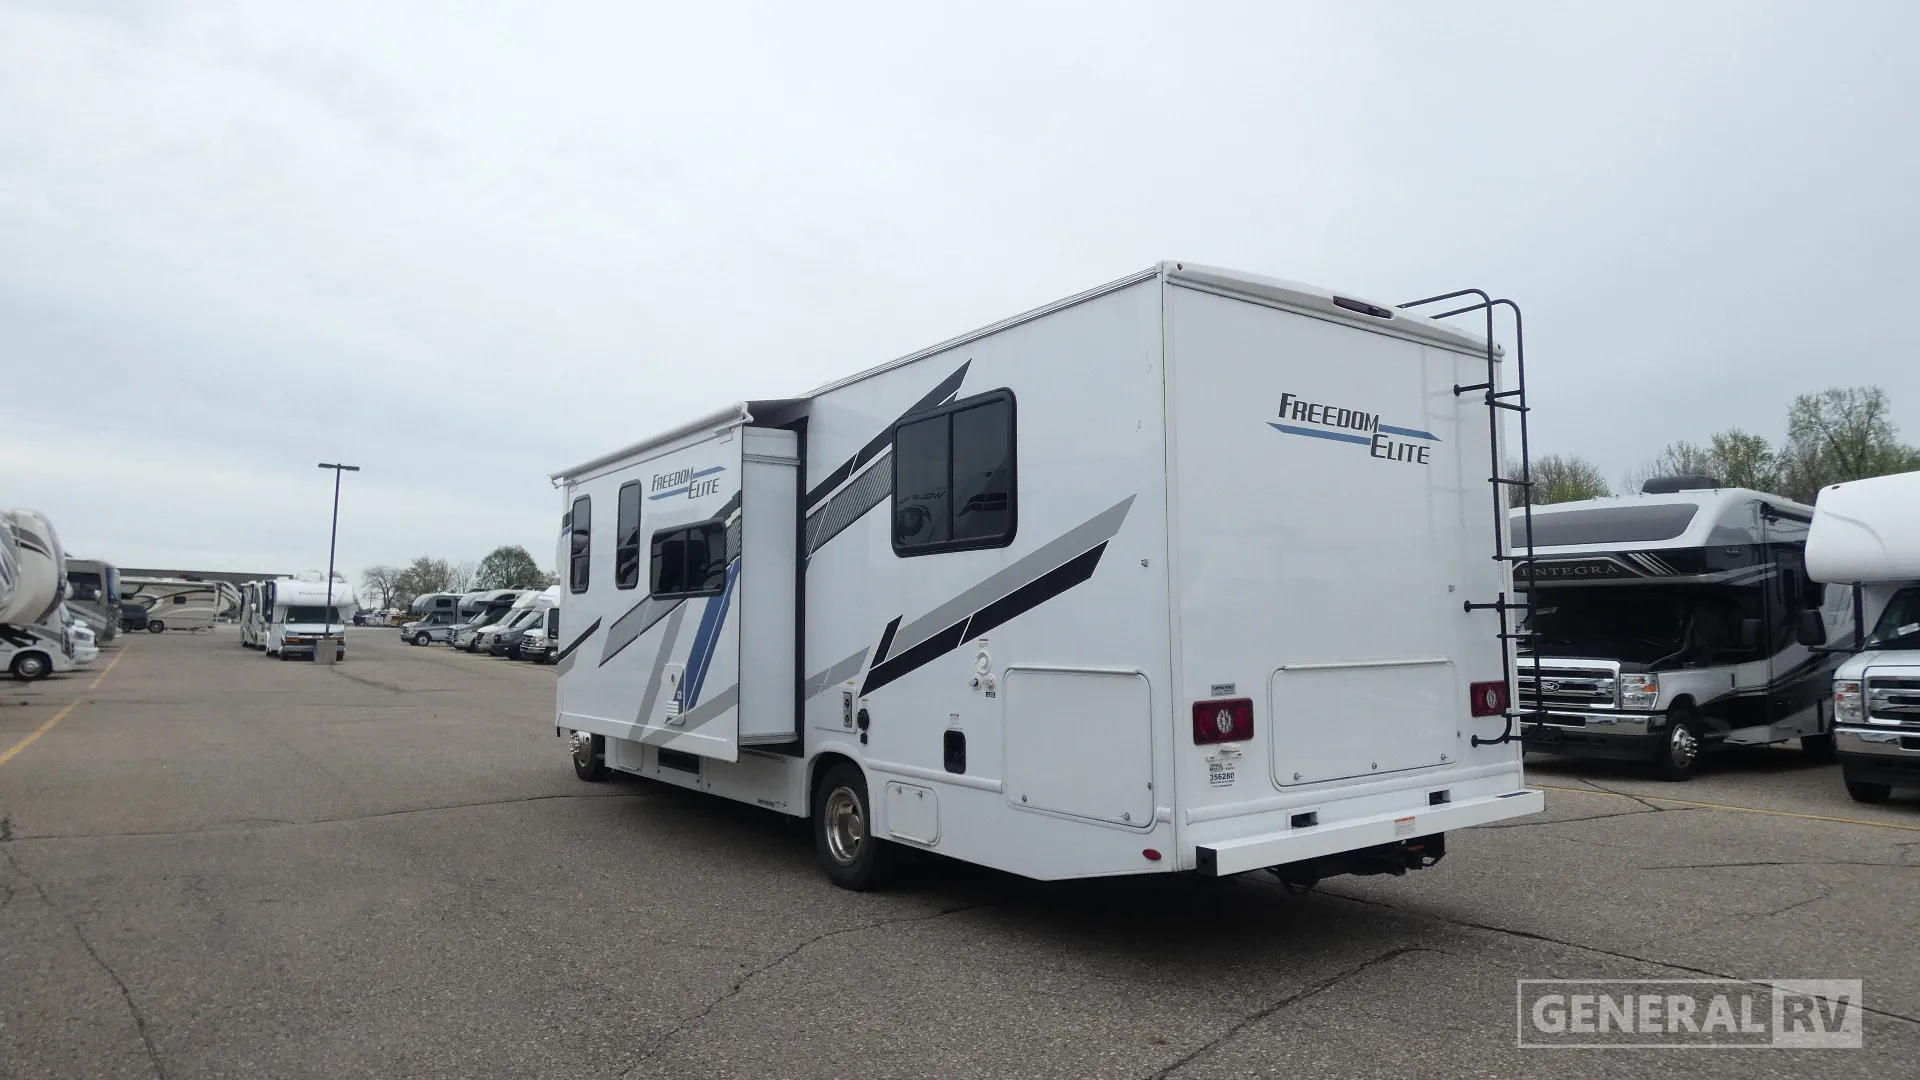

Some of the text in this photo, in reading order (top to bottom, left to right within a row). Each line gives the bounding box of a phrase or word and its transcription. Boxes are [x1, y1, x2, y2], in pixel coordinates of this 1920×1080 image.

[1278, 392, 1379, 434] FREEDOM
[1370, 433, 1431, 465] ELITE
[651, 467, 694, 492] FREEDOM
[687, 478, 720, 499] ELITE
